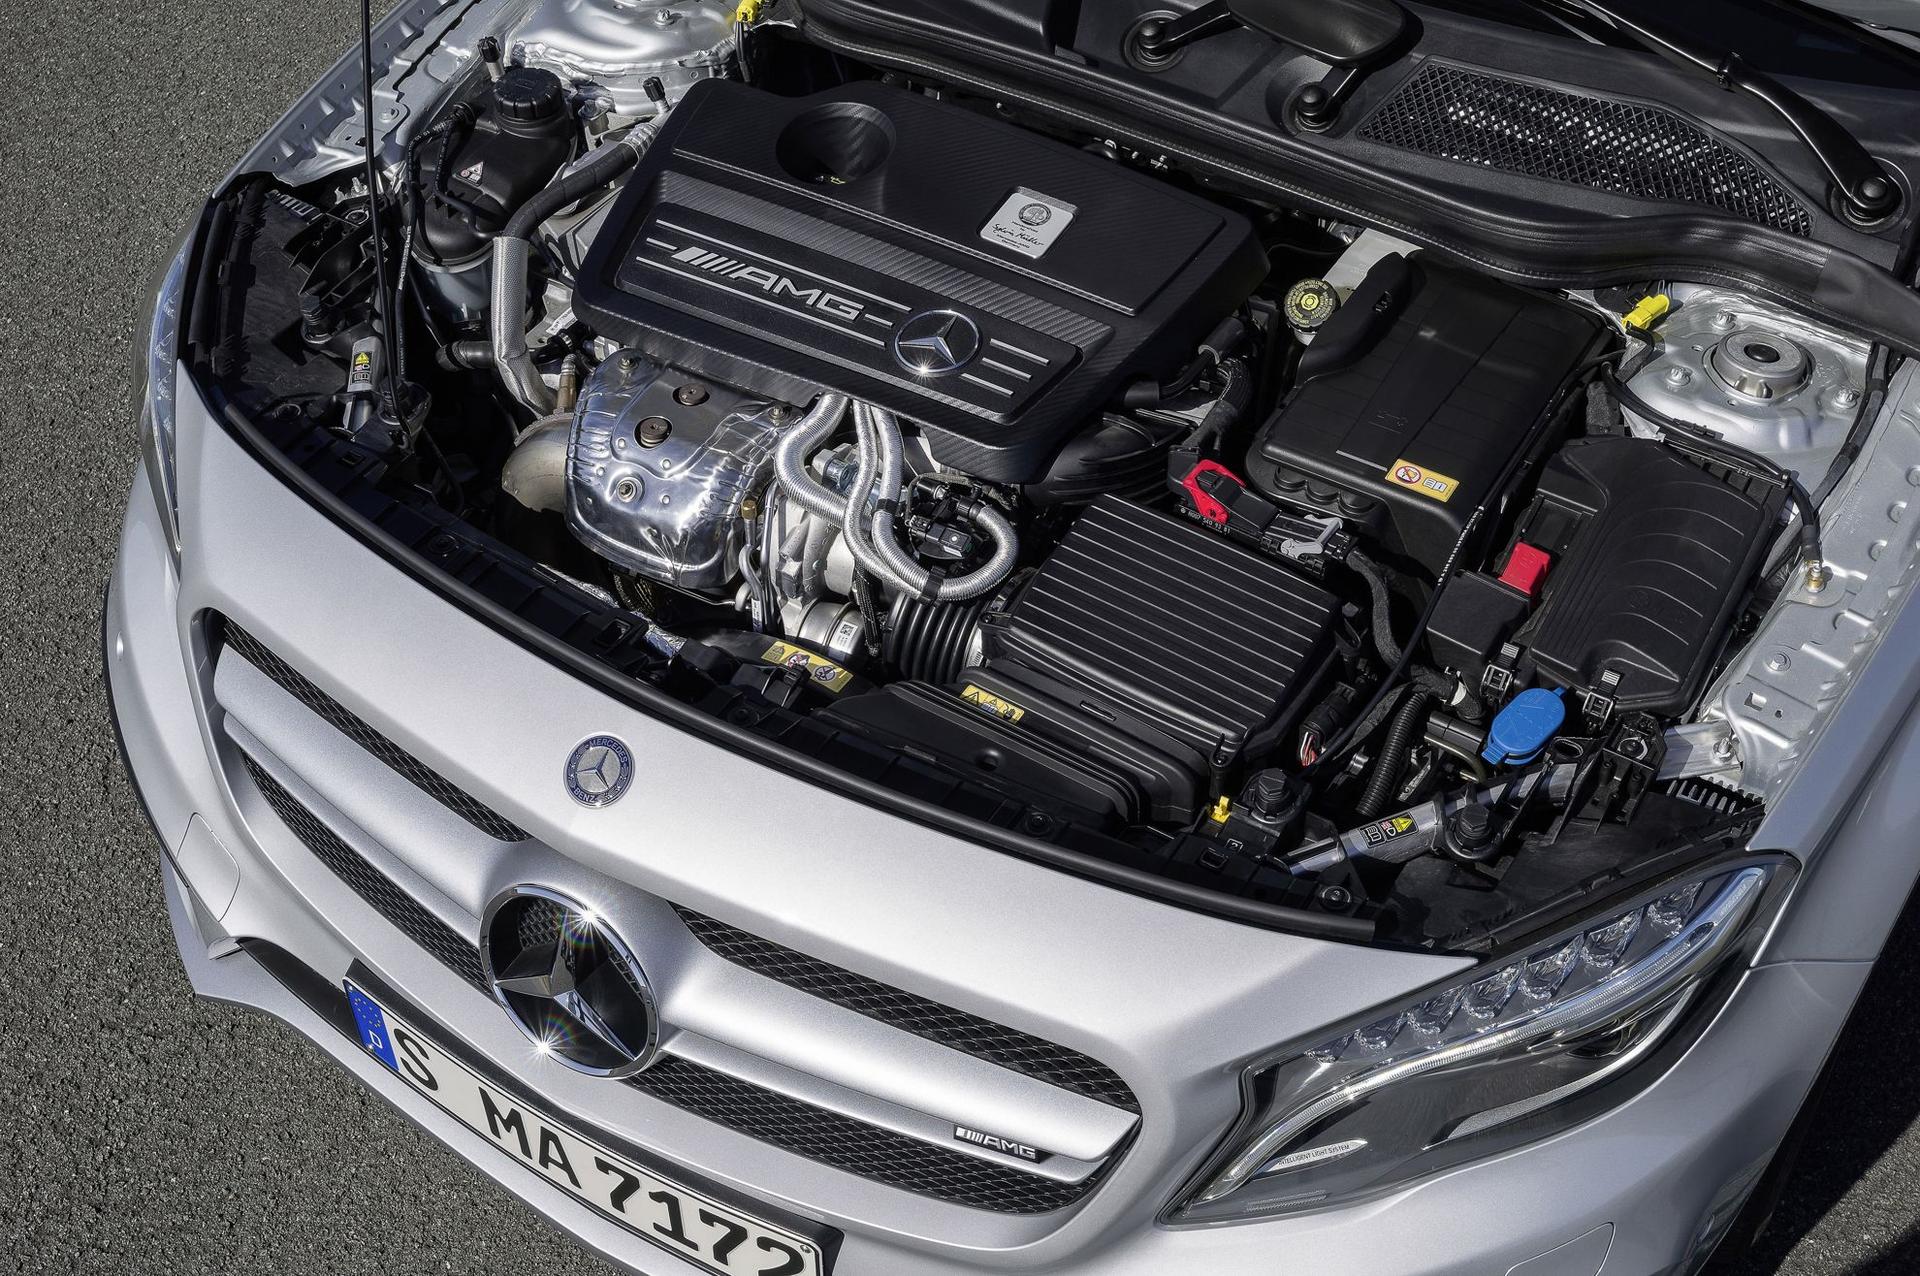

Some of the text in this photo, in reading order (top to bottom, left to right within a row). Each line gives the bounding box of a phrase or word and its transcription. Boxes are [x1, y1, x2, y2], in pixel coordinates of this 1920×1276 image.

[589, 738, 628, 763] MERCEDES
[573, 787, 596, 802] BENZ
[368, 1030, 383, 1050] D
[393, 1028, 805, 1276] S MA 7172
[1329, 1144, 1350, 1154] SYSTEM
